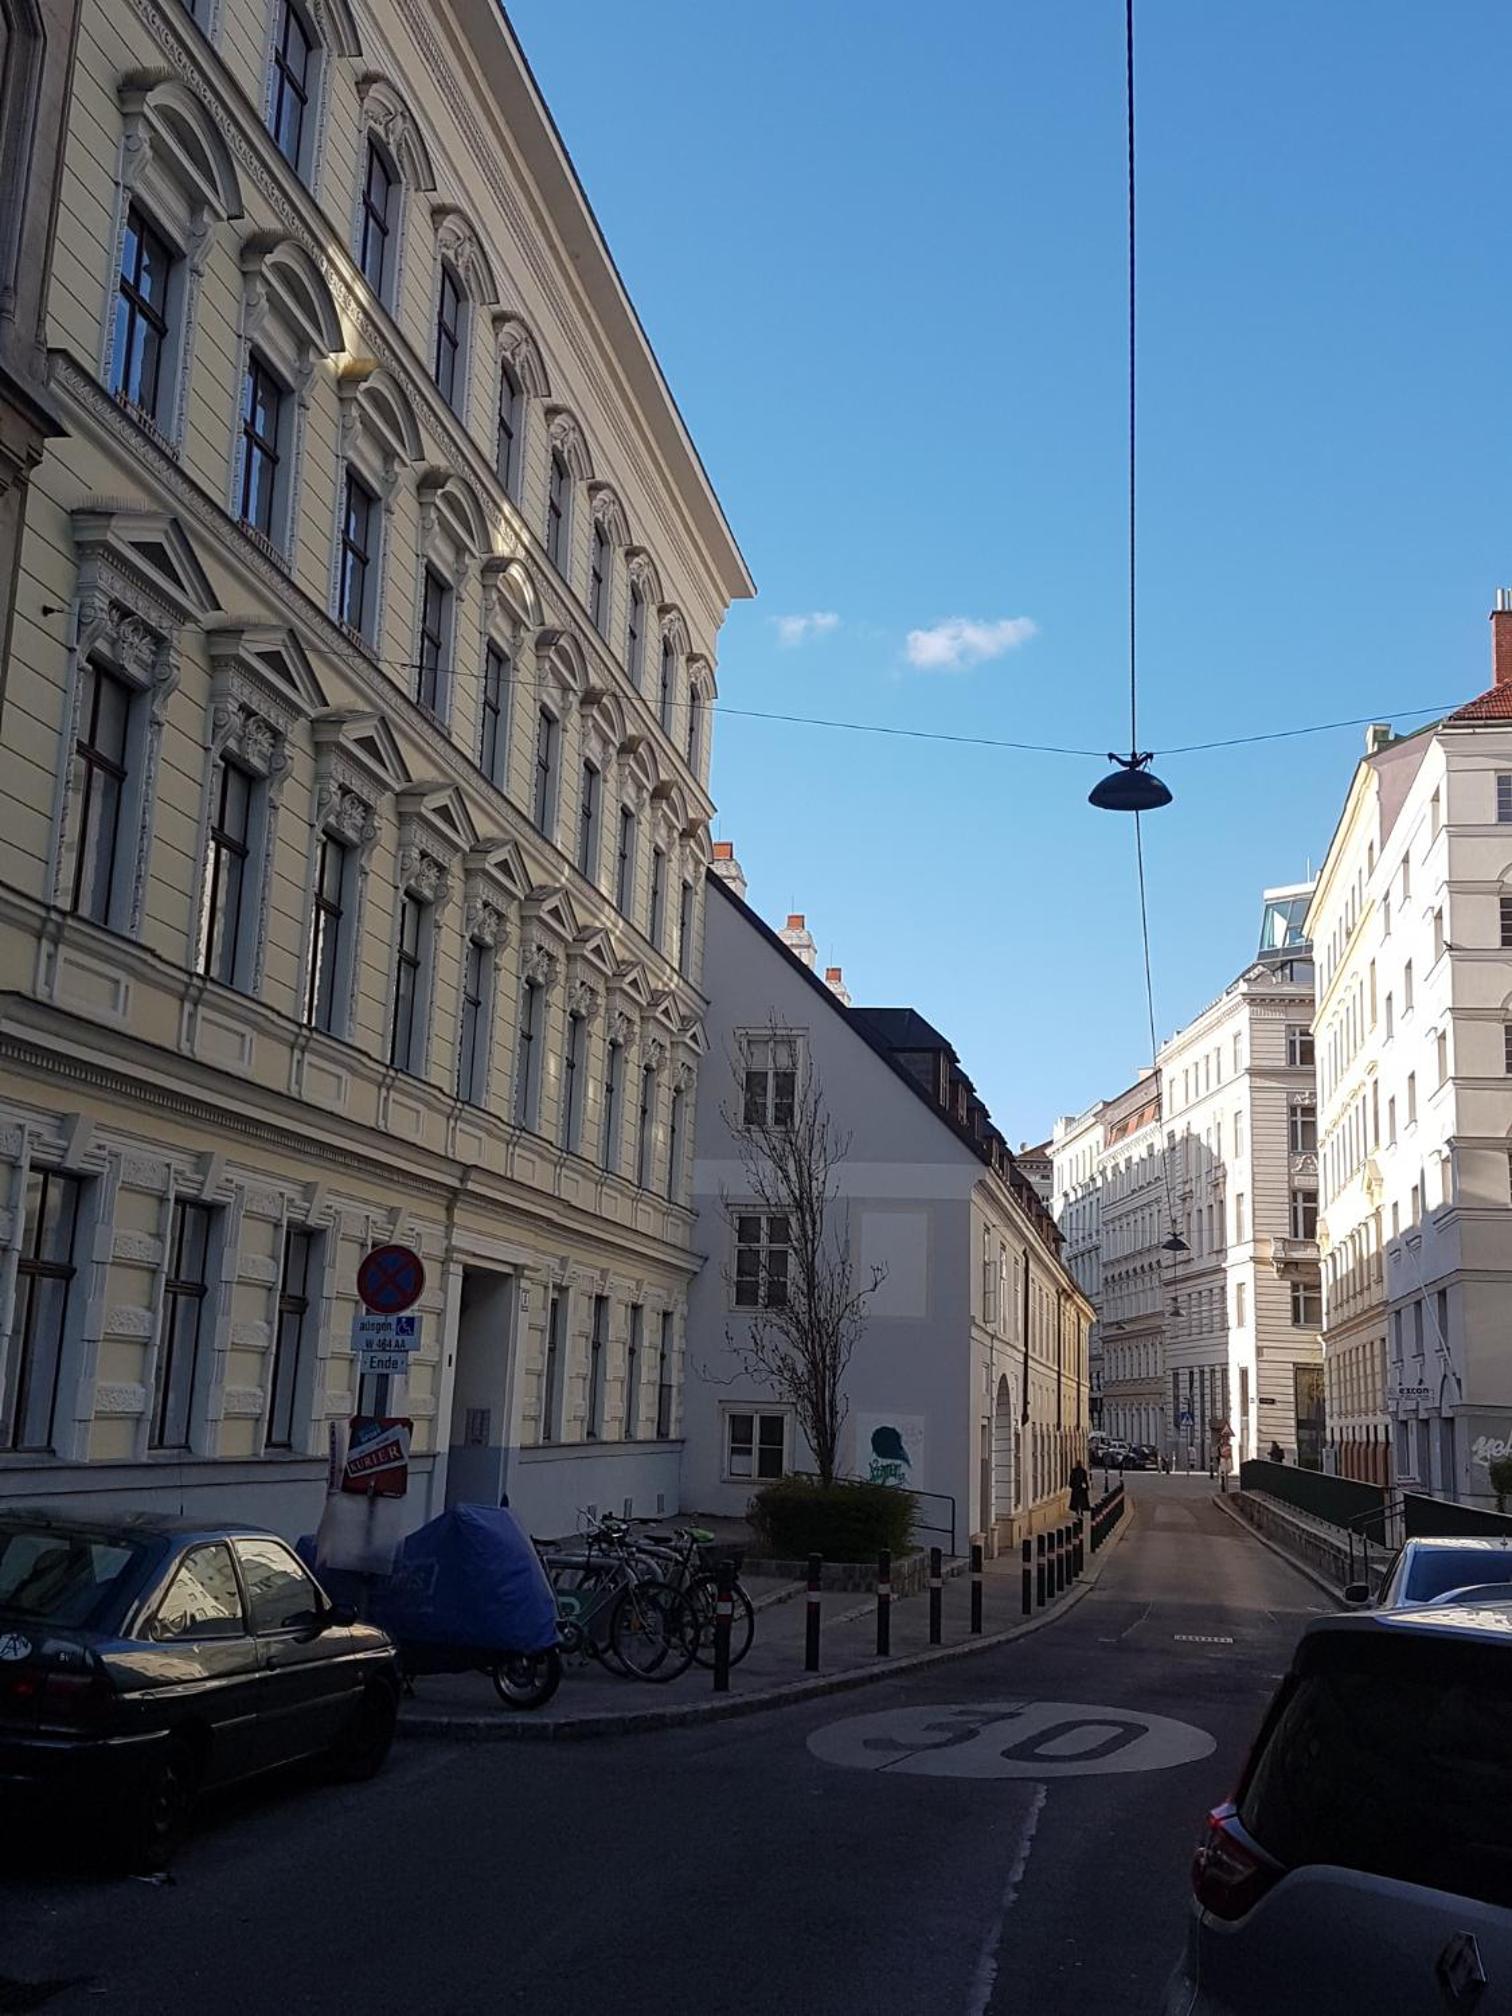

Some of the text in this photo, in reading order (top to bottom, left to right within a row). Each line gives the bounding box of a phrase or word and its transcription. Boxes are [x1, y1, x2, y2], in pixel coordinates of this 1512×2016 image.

[369, 1356, 399, 1369] Ende
[349, 1444, 402, 1473] KURIER
[863, 1709, 1149, 1763] 30
